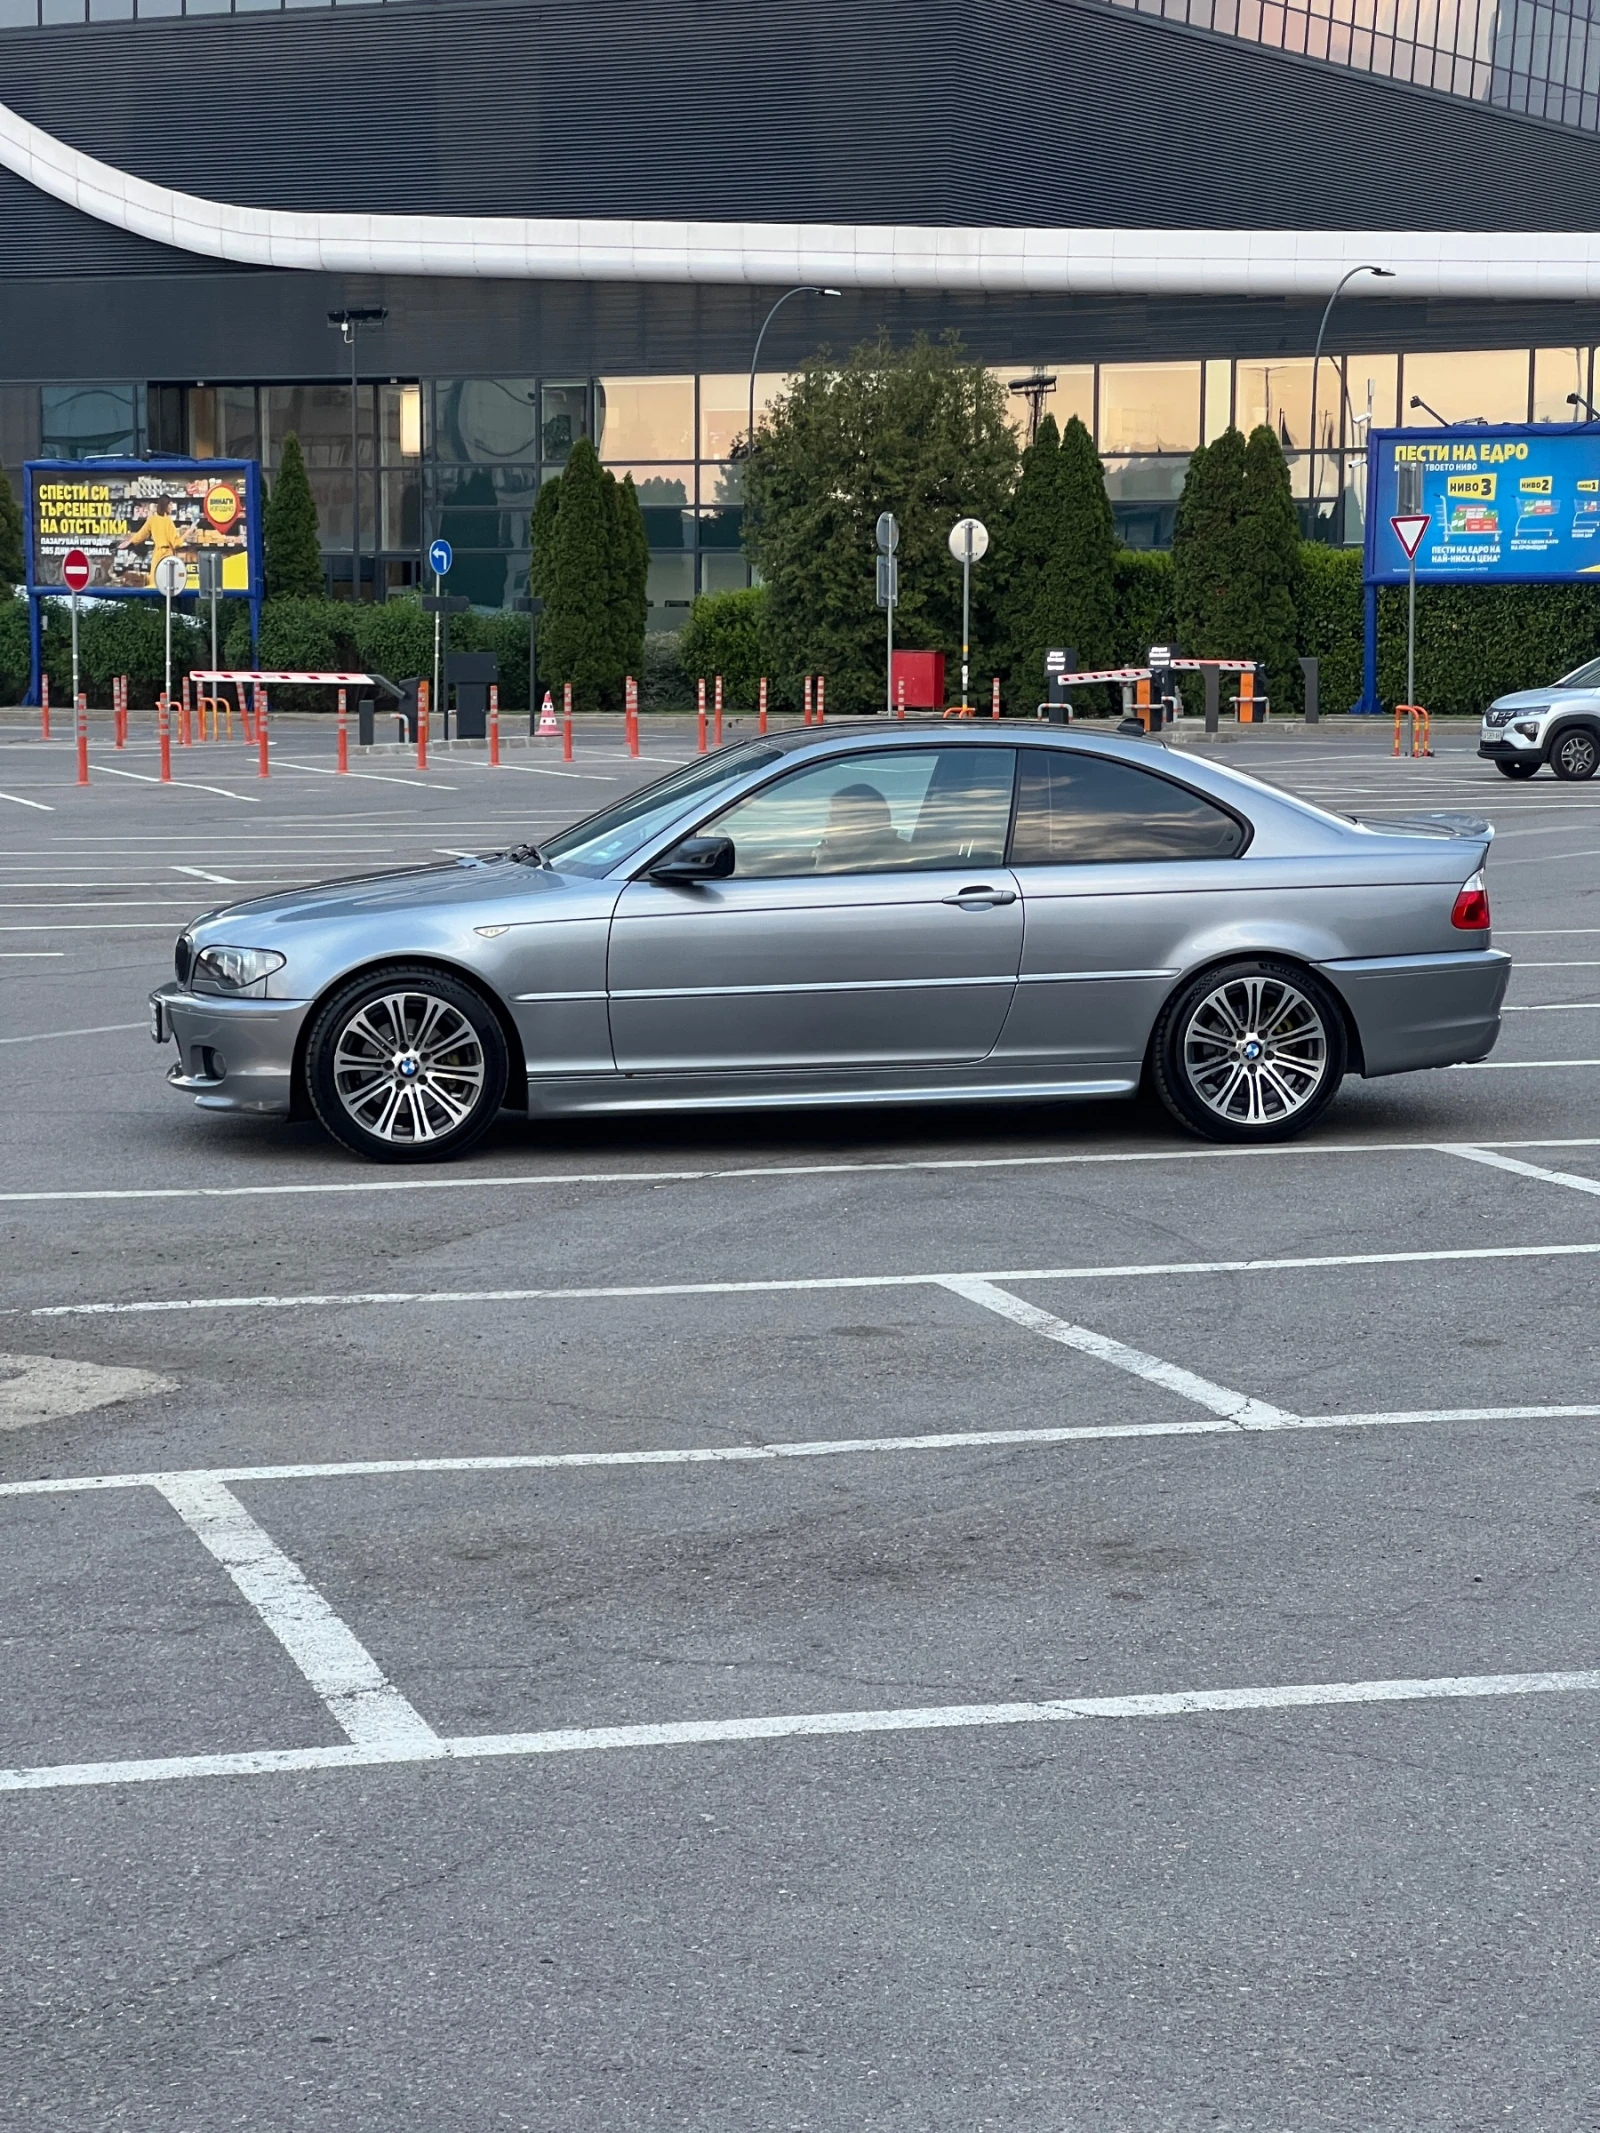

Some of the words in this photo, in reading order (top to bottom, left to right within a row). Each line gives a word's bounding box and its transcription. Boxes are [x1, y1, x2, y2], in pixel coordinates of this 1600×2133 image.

[1395, 445, 1449, 462] ПЕСТИ
[1453, 445, 1477, 461] НА
[1480, 443, 1528, 463] ЕДРО
[1425, 463, 1454, 471] ТВОЕТО
[1456, 463, 1477, 471] НИВО
[1450, 483, 1479, 492] НИВО
[1481, 478, 1492, 496] 3
[1541, 479, 1549, 491] 2
[1592, 482, 1597, 490] 1
[39, 485, 89, 500] СПЕСТИ
[91, 486, 109, 500] СИ
[39, 502, 112, 517] ТЪРСЕНЕТО
[40, 518, 58, 533] НА
[60, 519, 131, 534] ОТСТЪПКИ.
[41, 547, 53, 555] 365
[1431, 546, 1455, 554] ПЕСТИ
[1468, 545, 1489, 554] ЕДРО
[1490, 545, 1501, 553] НА
